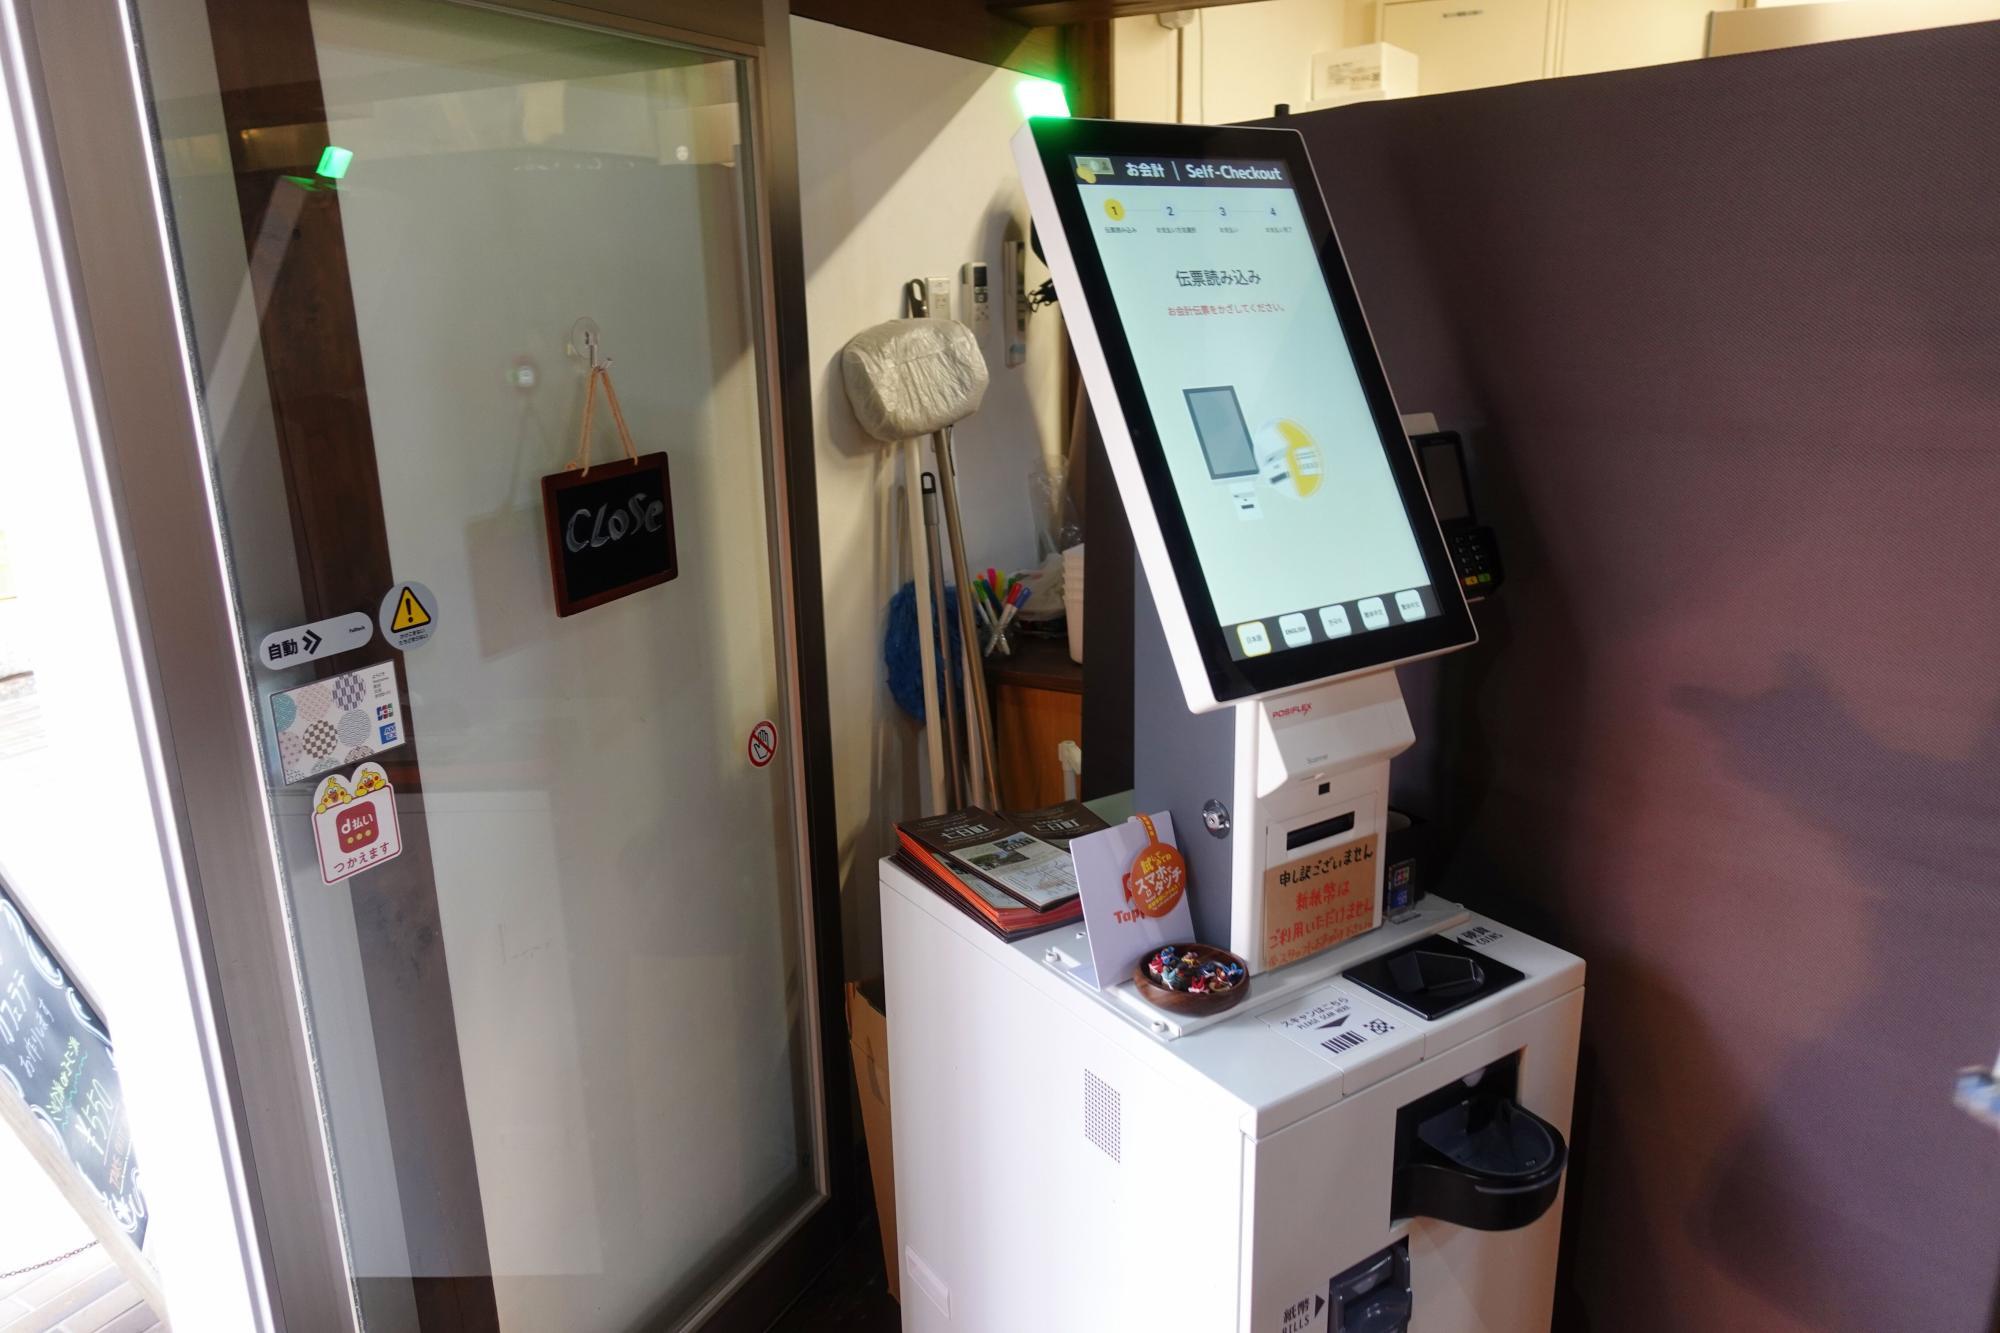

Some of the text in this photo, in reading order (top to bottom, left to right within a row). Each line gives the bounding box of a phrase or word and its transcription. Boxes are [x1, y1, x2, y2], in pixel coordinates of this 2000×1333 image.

[1125, 162, 1283, 181] お会計 Self-Checkout
[1110, 206, 1277, 217] 1 2 3 4
[1176, 269, 1261, 287] 伝票読み込み
[267, 639, 299, 661] 自動
[340, 814, 374, 834] d払い
[333, 843, 390, 873] つかえます
[1279, 844, 1374, 887] 申し訳ございません
[1268, 900, 1374, 948] ご利用いただけません
[1280, 996, 1350, 1028] スキャンはこちら
